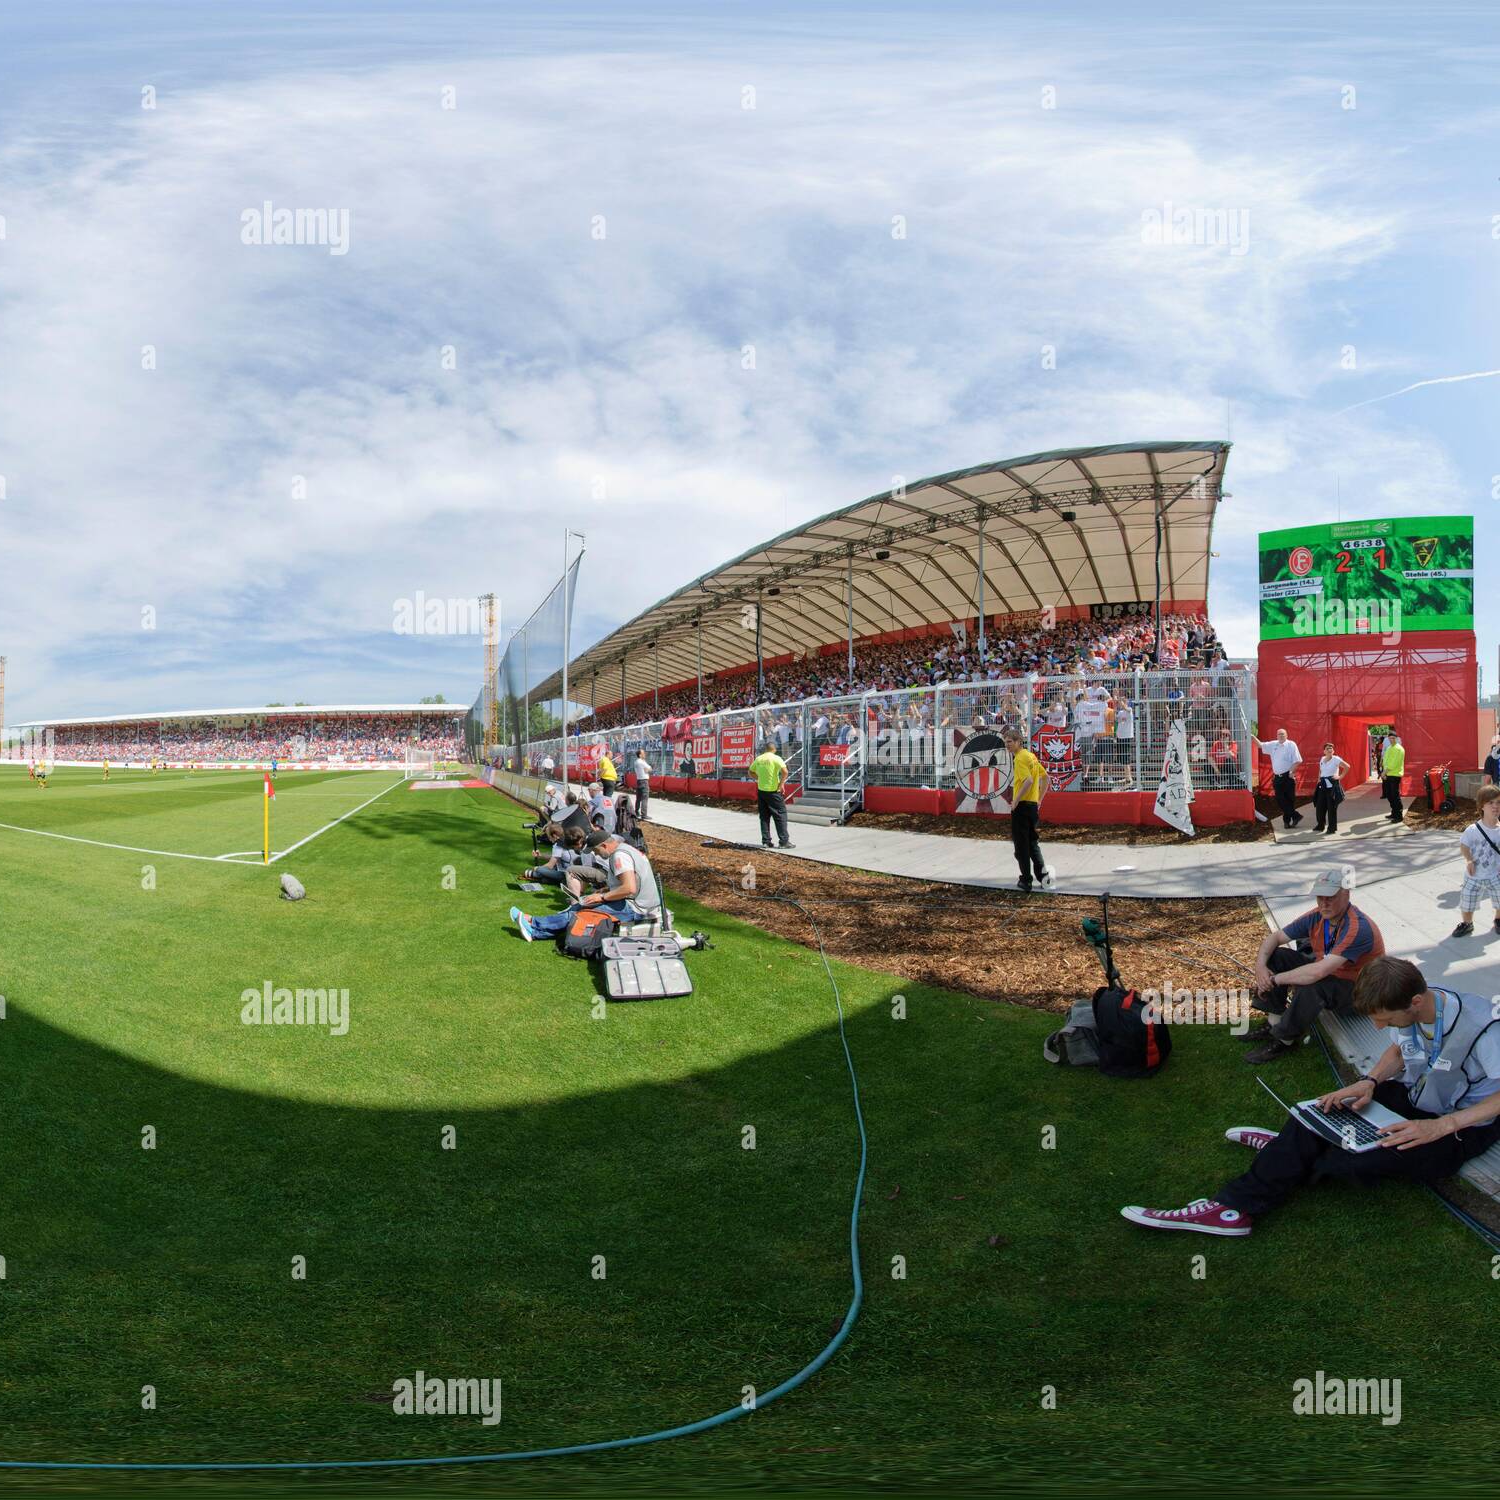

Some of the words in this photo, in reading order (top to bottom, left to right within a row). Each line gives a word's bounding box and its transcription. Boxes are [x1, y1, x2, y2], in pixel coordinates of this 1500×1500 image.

[1344, 539, 1382, 548] 46:38
[1335, 550, 1352, 573] 2
[1373, 548, 1386, 570] 1
